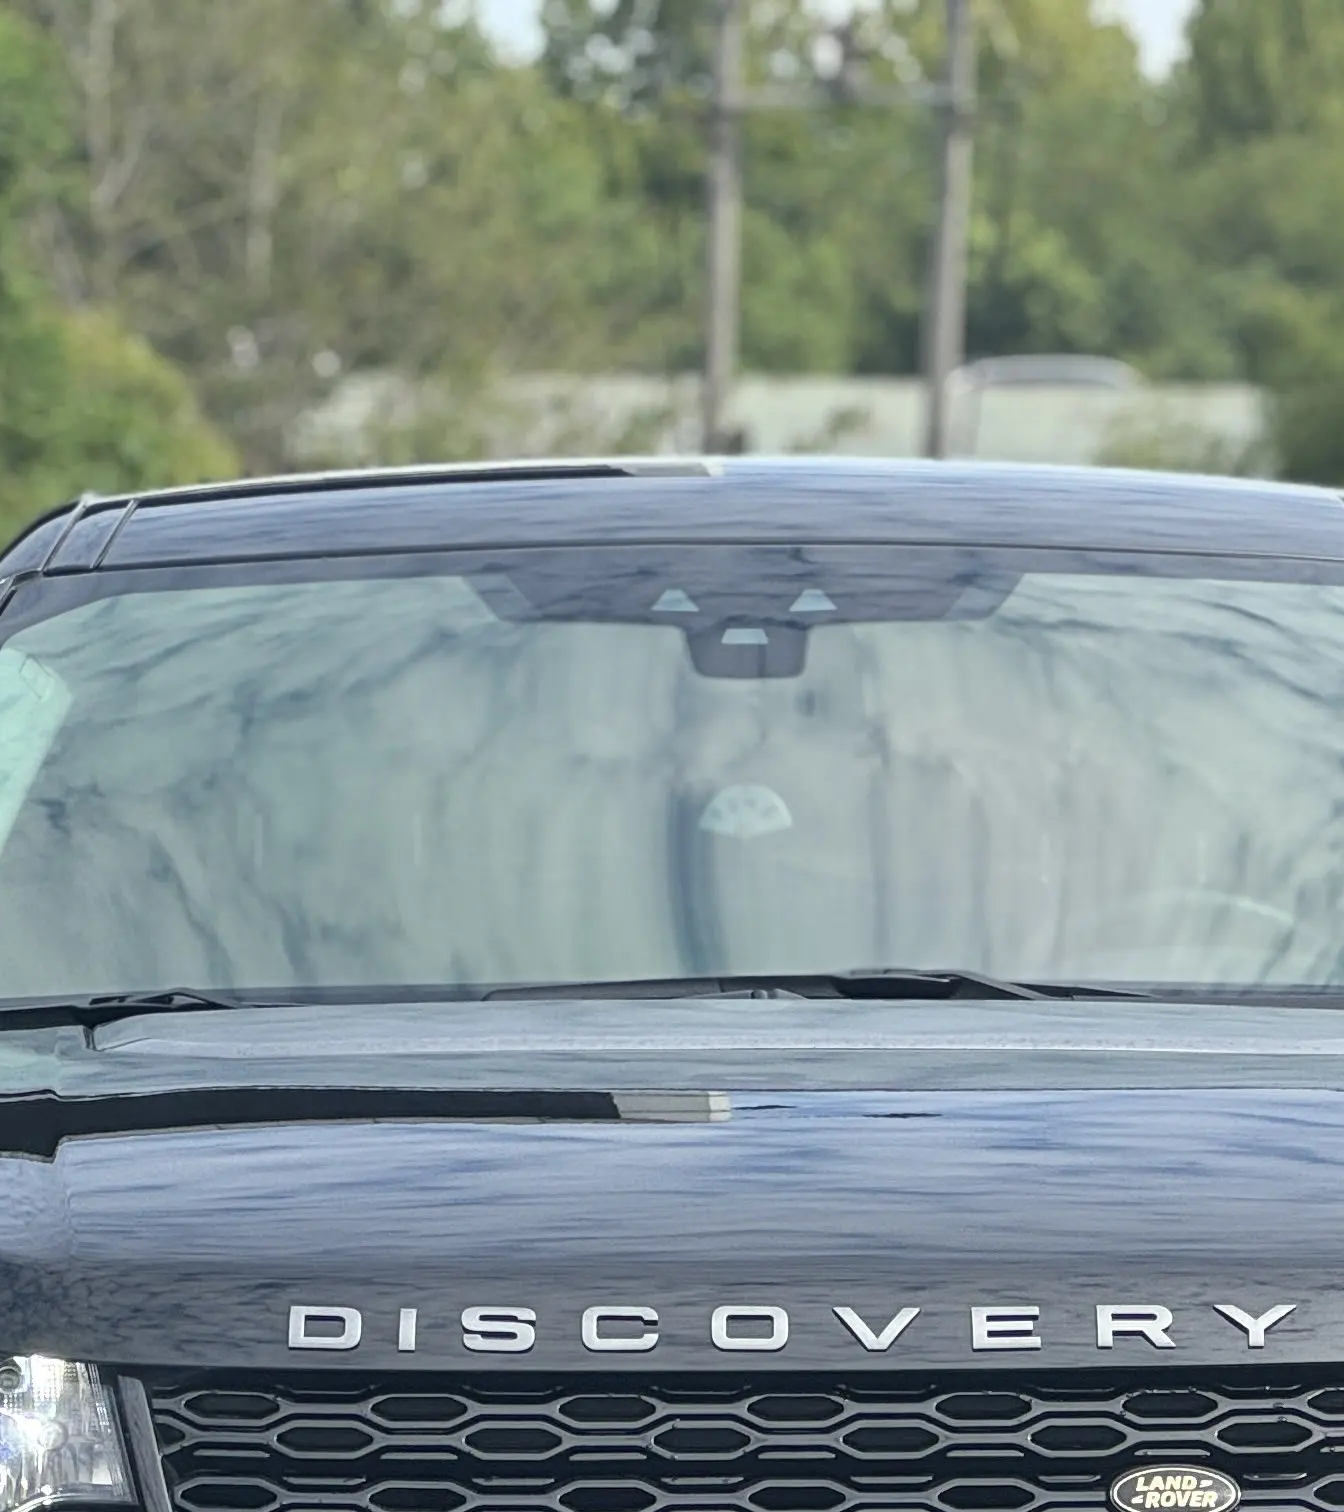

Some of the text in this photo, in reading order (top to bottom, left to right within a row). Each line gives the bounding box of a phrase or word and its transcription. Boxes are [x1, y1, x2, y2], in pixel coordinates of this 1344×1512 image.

[287, 1303, 1298, 1352] DISCOVERY
[1135, 1475, 1198, 1492] LAND
[1144, 1490, 1219, 1509] ROVER
